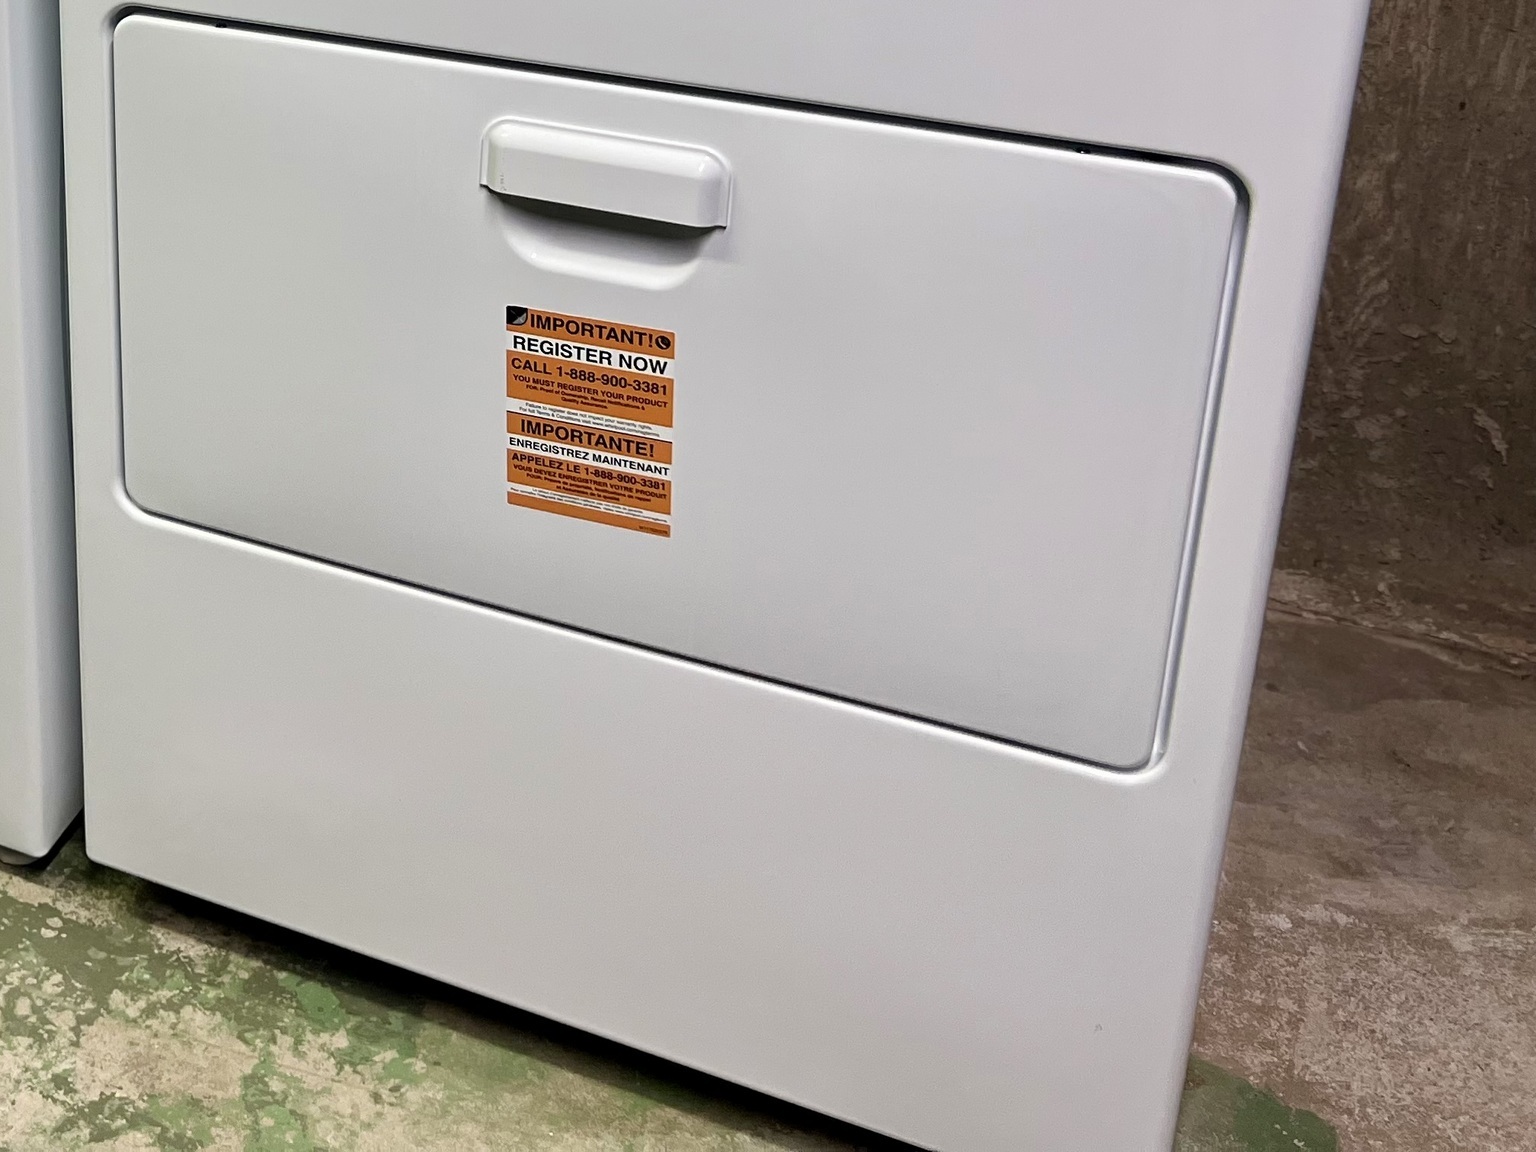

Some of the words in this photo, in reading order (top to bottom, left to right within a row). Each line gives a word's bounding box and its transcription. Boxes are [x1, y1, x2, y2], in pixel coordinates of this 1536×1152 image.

[530, 313, 652, 347] IMPORTANT!
[513, 335, 611, 365] REGISTER
[619, 354, 667, 375] NOW
[511, 357, 551, 375] CALL
[556, 365, 667, 396] 1-888-900-3381
[513, 374, 530, 383] YOU
[532, 377, 554, 387] MUST
[557, 382, 598, 395] REGISTER
[600, 389, 624, 400] YOUR
[626, 394, 668, 408] PRODUCT
[509, 437, 589, 460] ENREGISTREZ
[592, 453, 669, 476] MAINTENANT
[521, 418, 654, 457] IMPORTANTE!
[511, 452, 563, 470] APPELEZ
[567, 463, 580, 473] LE
[585, 467, 665, 491] 1-888-900-3381
[513, 463, 532, 472] VOUS
[533, 467, 556, 477] DEVEZ
[558, 472, 607, 487] ENREGISTRER
[609, 483, 633, 493] VOTRE
[635, 488, 666, 499] PRODUIT
